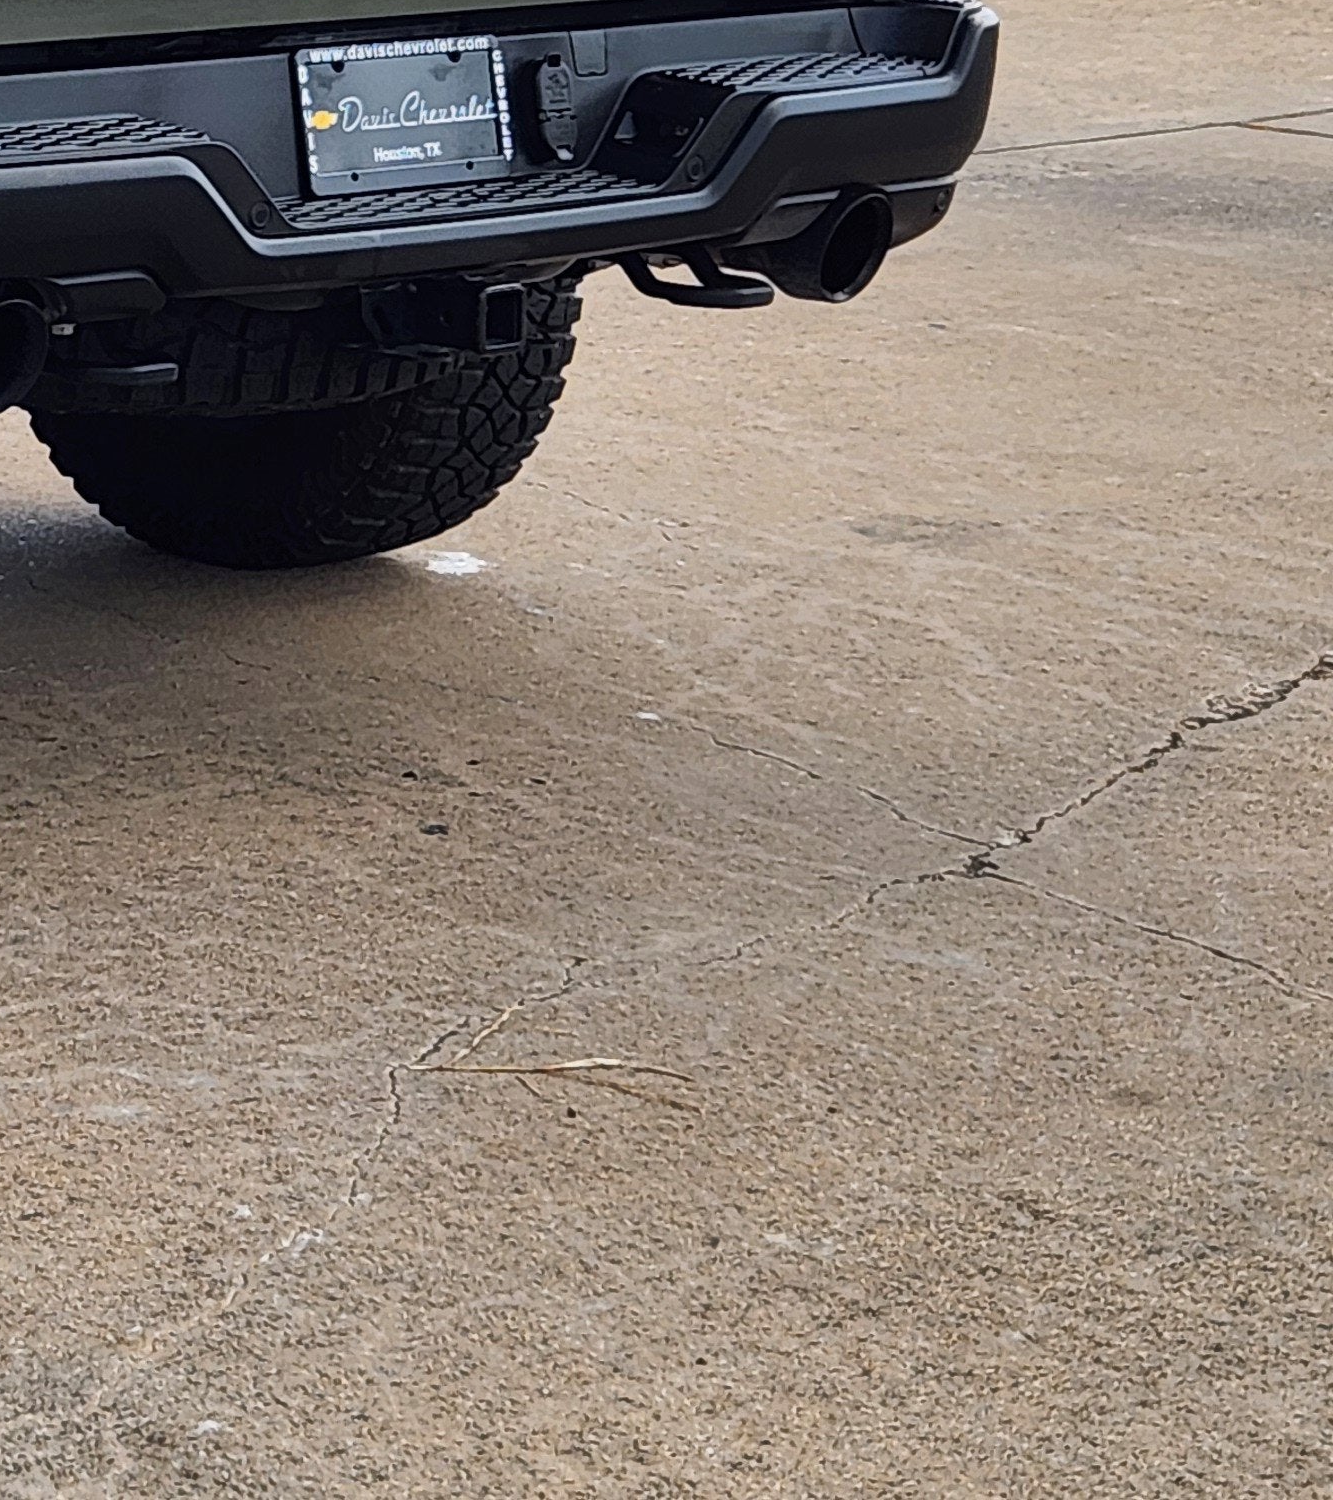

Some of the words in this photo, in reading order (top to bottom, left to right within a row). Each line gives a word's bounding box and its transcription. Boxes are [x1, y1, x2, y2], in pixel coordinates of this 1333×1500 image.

[309, 35, 490, 62] www.davischevrolet.com
[337, 96, 401, 132] Davis
[399, 90, 498, 127] Chevrolet
[423, 141, 443, 157] TX
